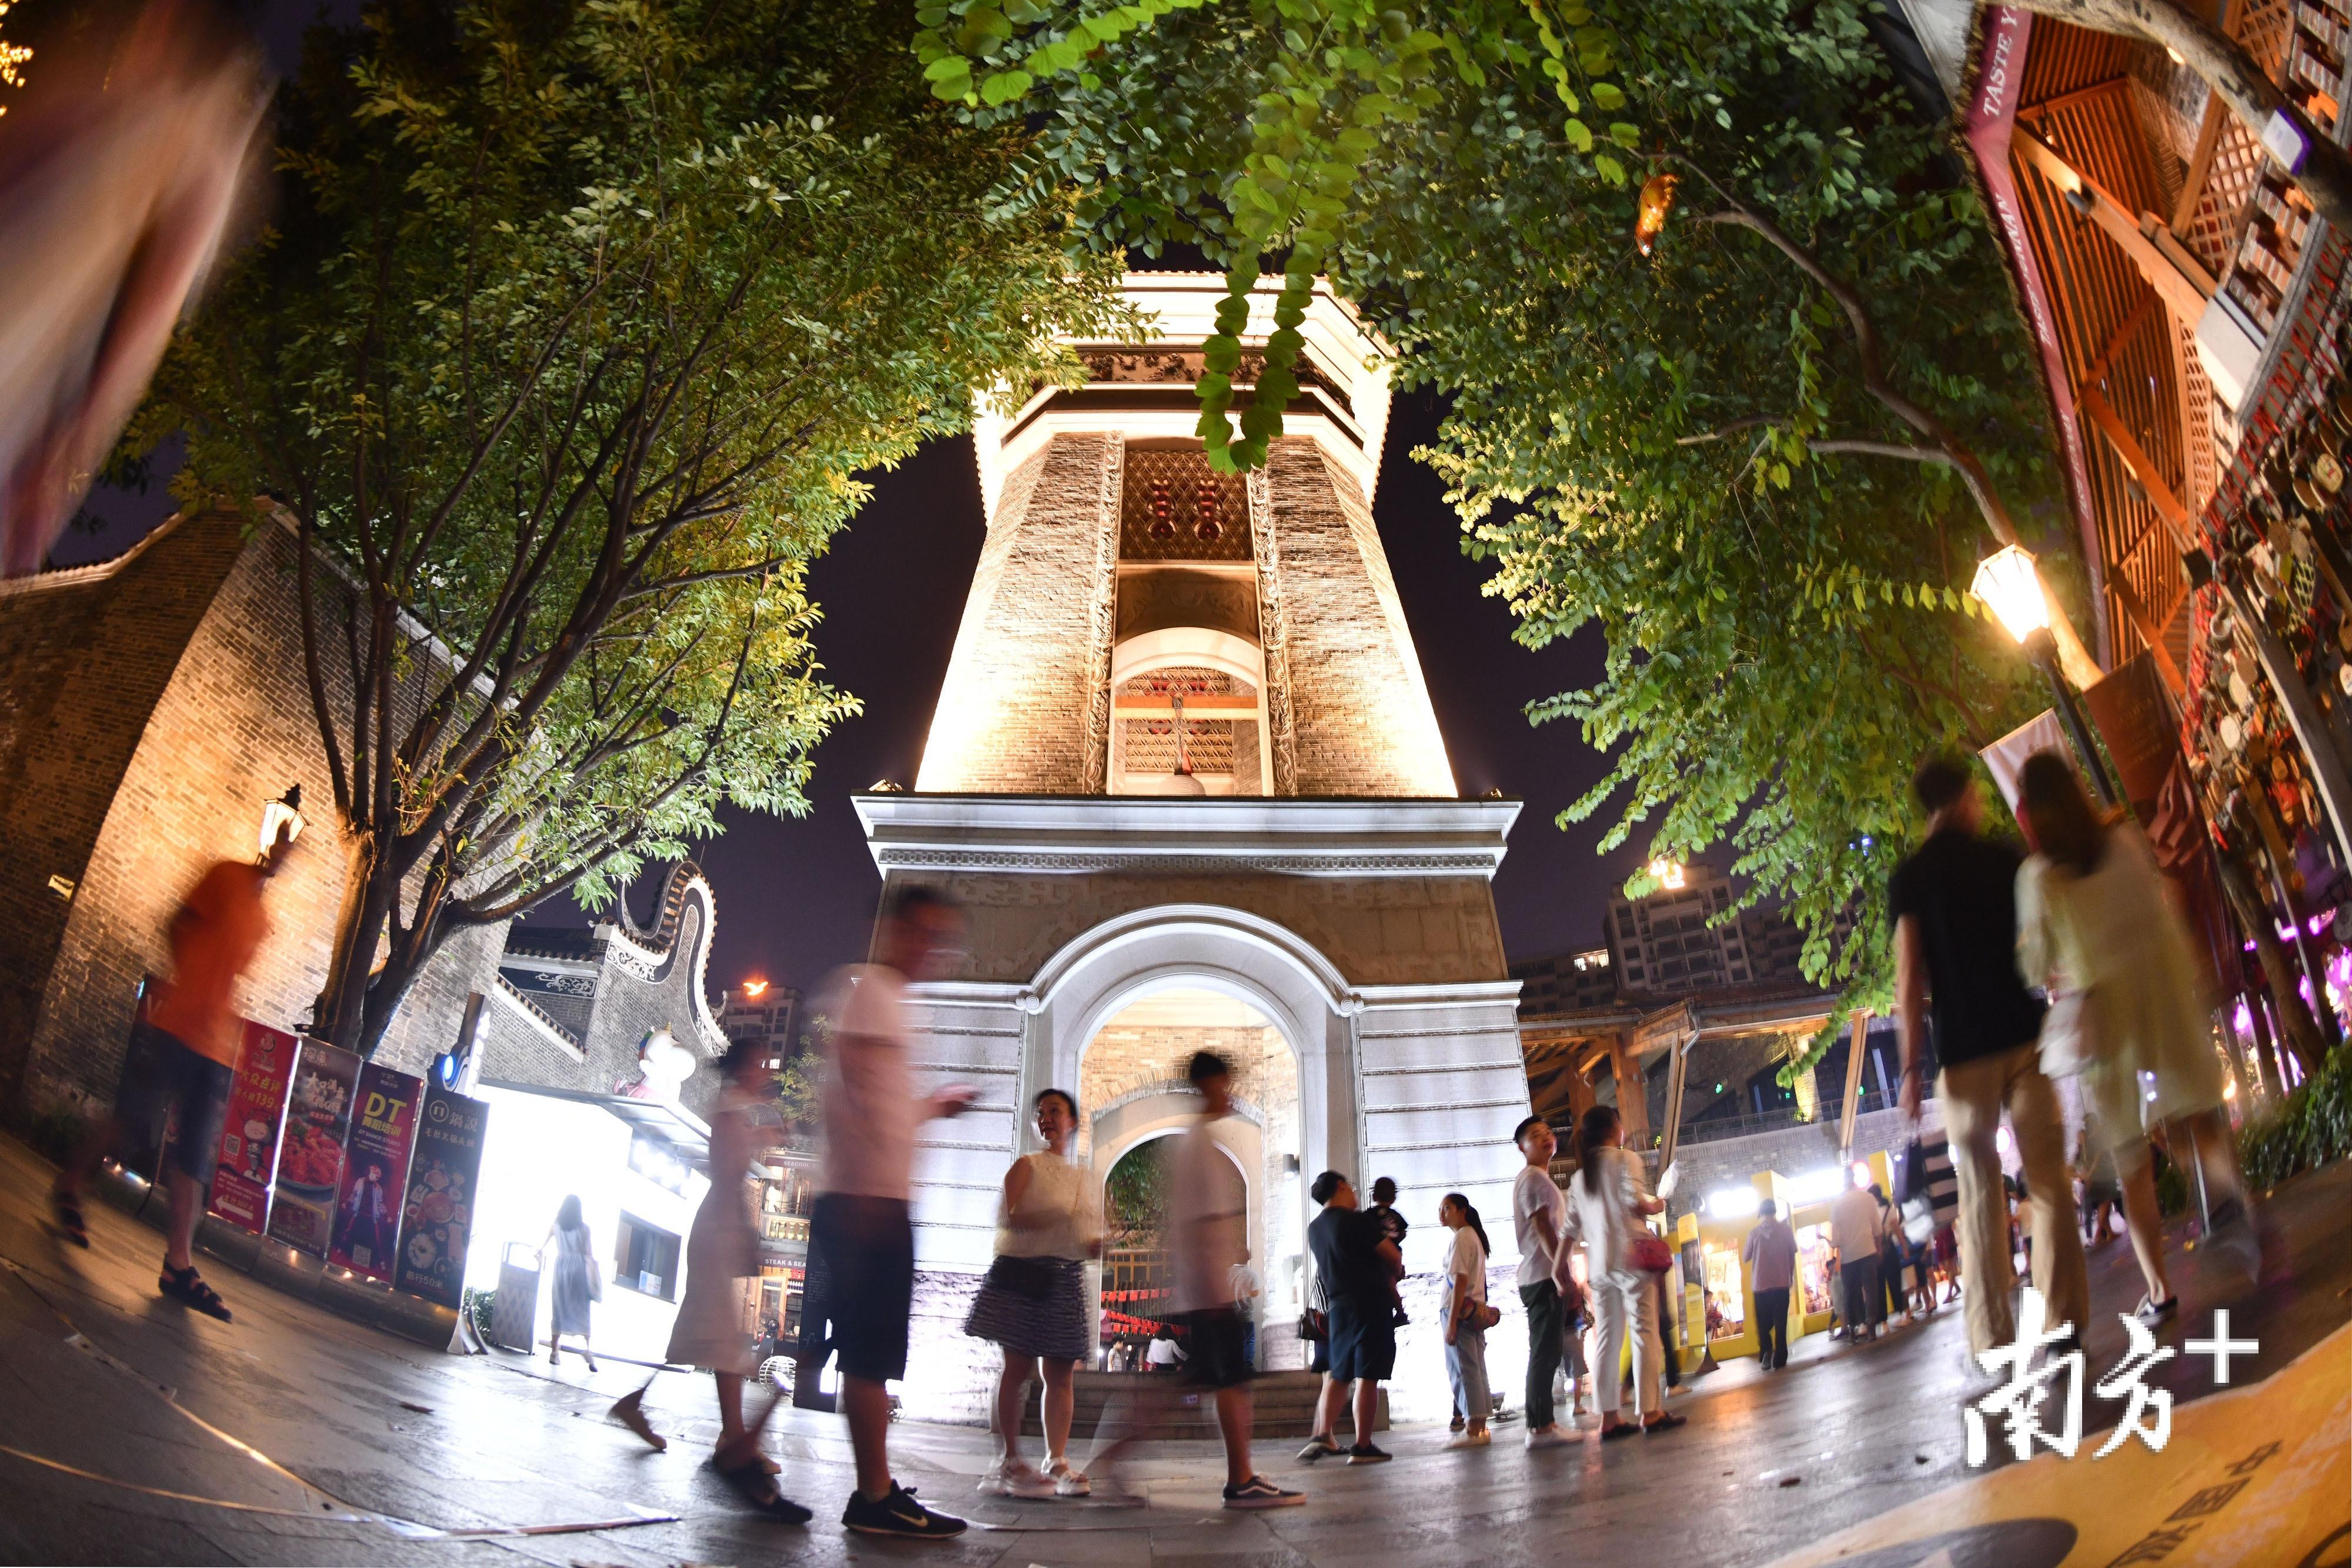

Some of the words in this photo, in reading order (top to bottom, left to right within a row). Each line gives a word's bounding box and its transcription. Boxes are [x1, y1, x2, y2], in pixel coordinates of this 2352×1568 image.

[1983, 33, 2013, 116] TASTE
[363, 1091, 407, 1124] DT
[361, 1114, 402, 1138] 舞蹈培训
[365, 1131, 382, 1142] DANCE
[382, 1136, 401, 1148] STUDIO
[406, 1270, 443, 1289] 前行50米
